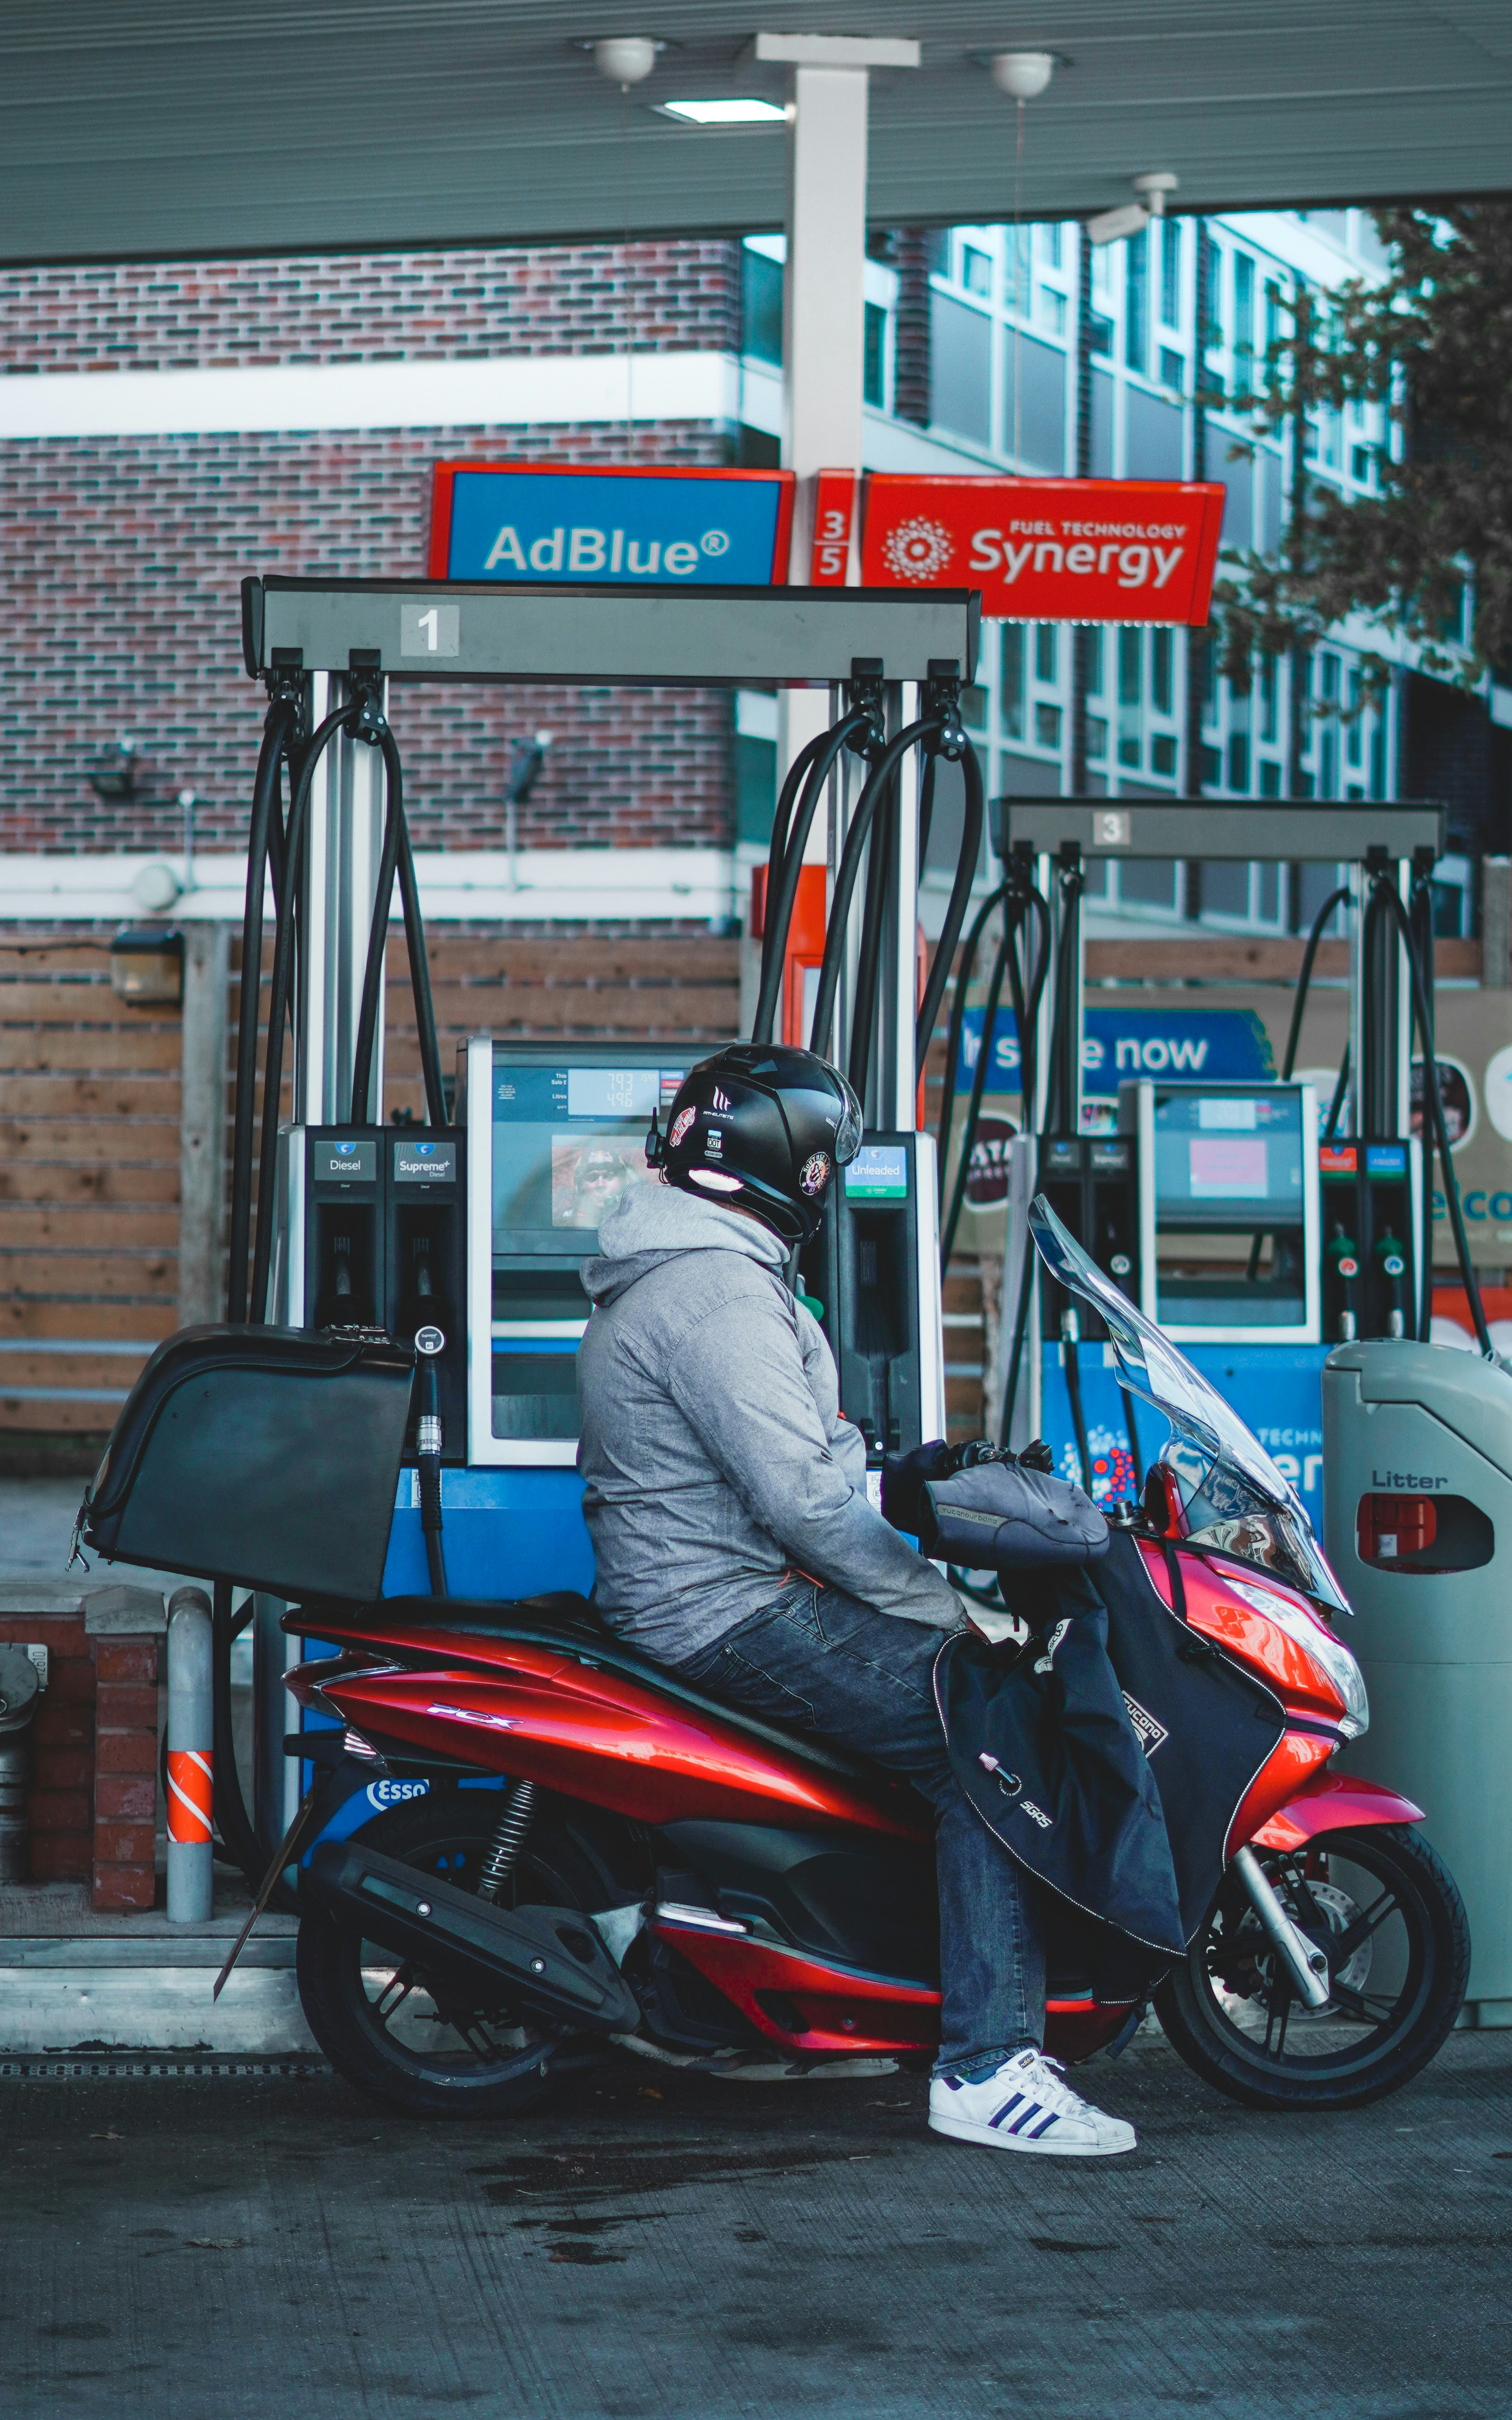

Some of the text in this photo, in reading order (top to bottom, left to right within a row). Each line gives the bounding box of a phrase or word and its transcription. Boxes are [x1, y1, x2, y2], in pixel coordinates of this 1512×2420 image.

[823, 511, 844, 540] 3
[1010, 520, 1187, 540] FUEL TECHNOLOGY
[820, 547, 842, 575] 5
[969, 528, 1184, 589] Synergy
[418, 609, 437, 650] 1
[1103, 814, 1121, 843] 3
[1116, 1038, 1208, 1070] now
[708, 1139, 720, 1147] DOT
[330, 1160, 361, 1170] Diesel
[852, 1165, 900, 1175] Unleaded
[1257, 1428, 1322, 1447] TECHN
[1372, 1470, 1448, 1489] Litter
[426, 1702, 524, 1730] PCX
[378, 1780, 426, 1800] Esso
[1019, 1801, 1053, 1828] SGAS
[989, 2095, 1009, 2116] SUPERSTAR
